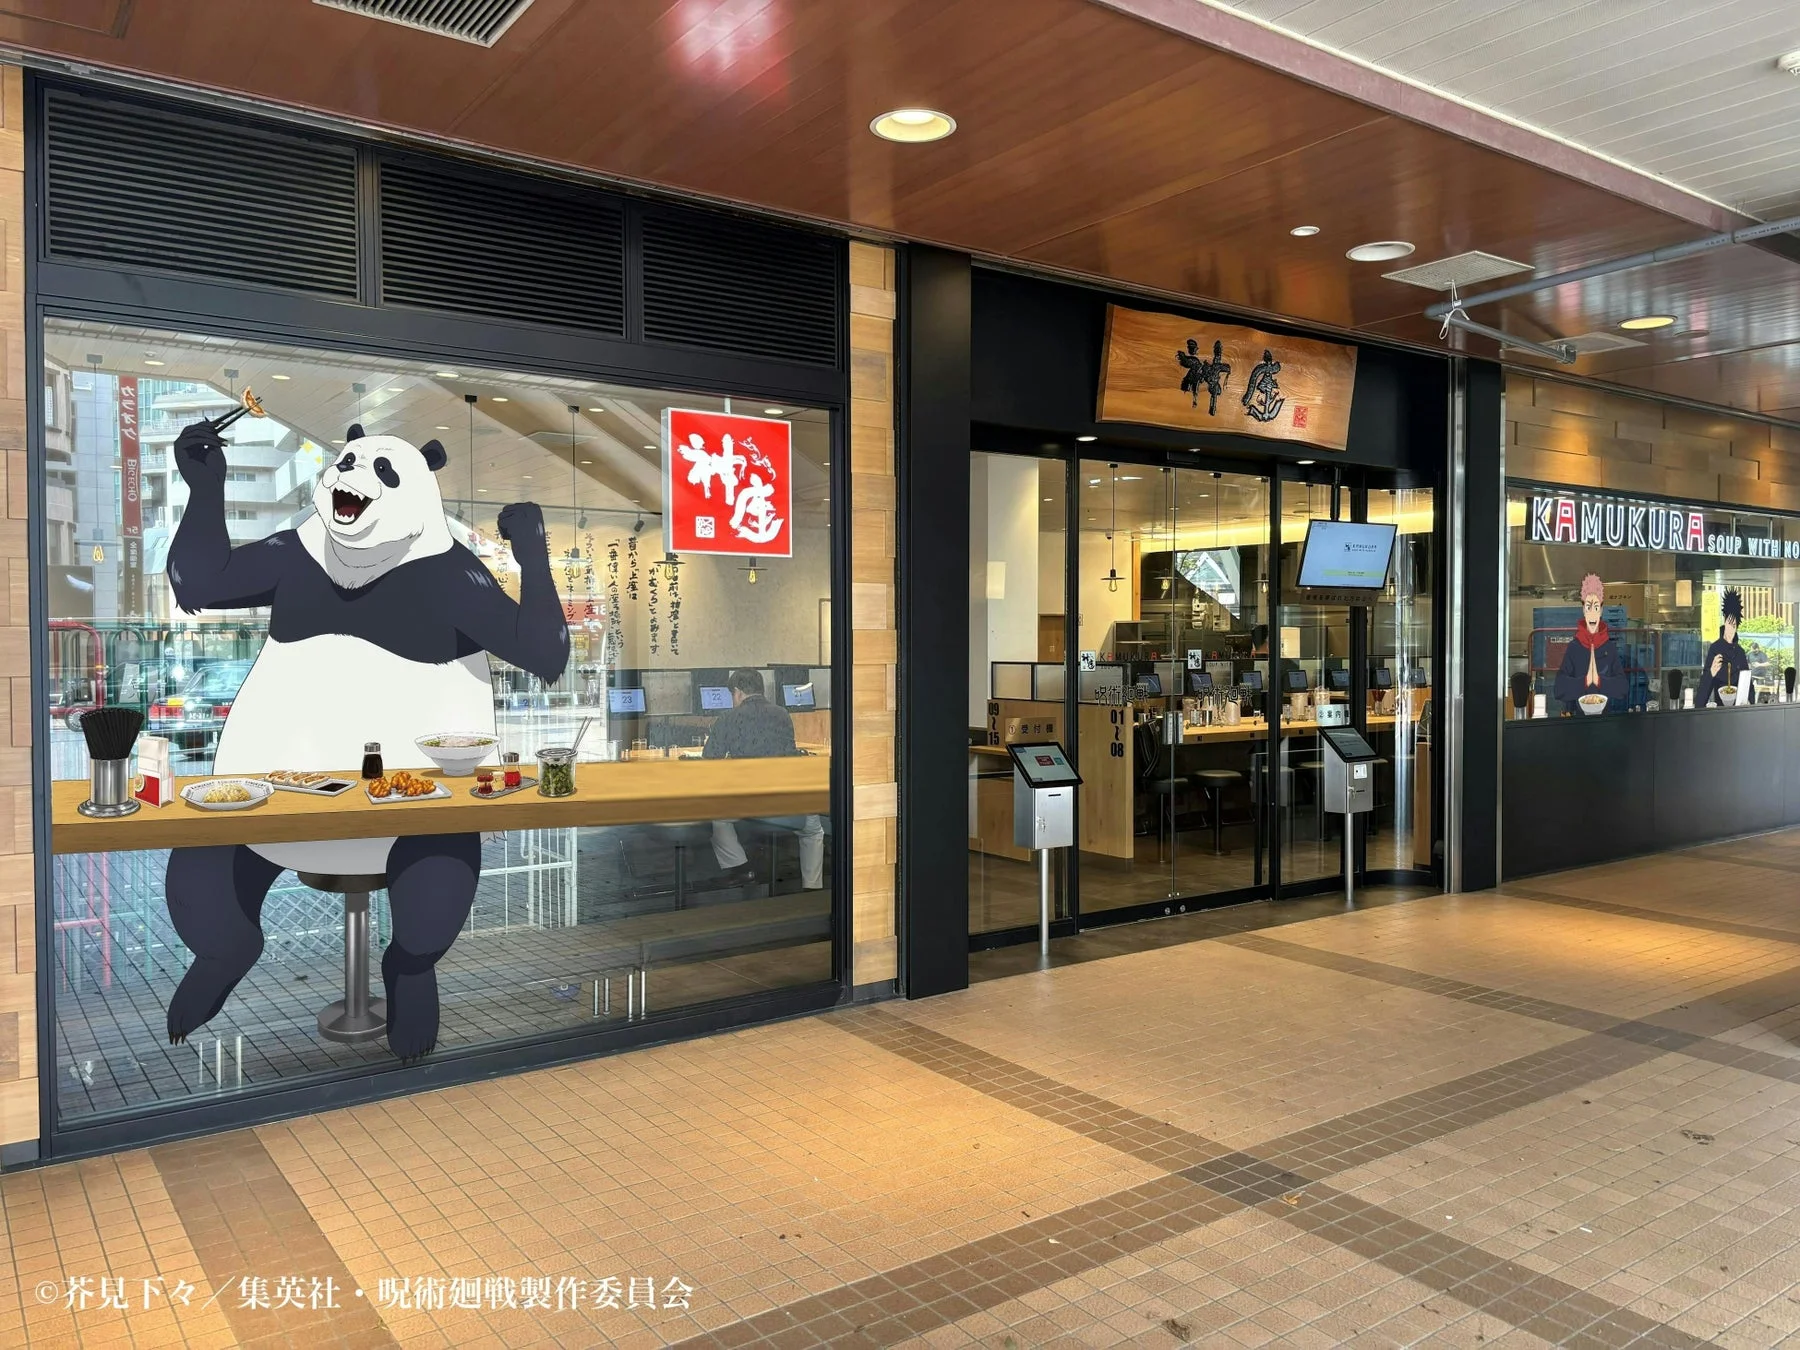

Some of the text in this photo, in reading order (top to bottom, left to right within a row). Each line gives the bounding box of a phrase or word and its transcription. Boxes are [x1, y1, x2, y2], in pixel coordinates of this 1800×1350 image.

[1176, 338, 1286, 423] 神座
[677, 433, 785, 544] 神座
[1531, 496, 1800, 559] KAMUKURA SOUP WITH NO
[621, 695, 633, 704] 23
[711, 693, 722, 702] 22
[988, 702, 1000, 717] 09
[1110, 709, 1124, 725] 01
[988, 731, 1000, 745] 15
[1110, 742, 1124, 757] 08
